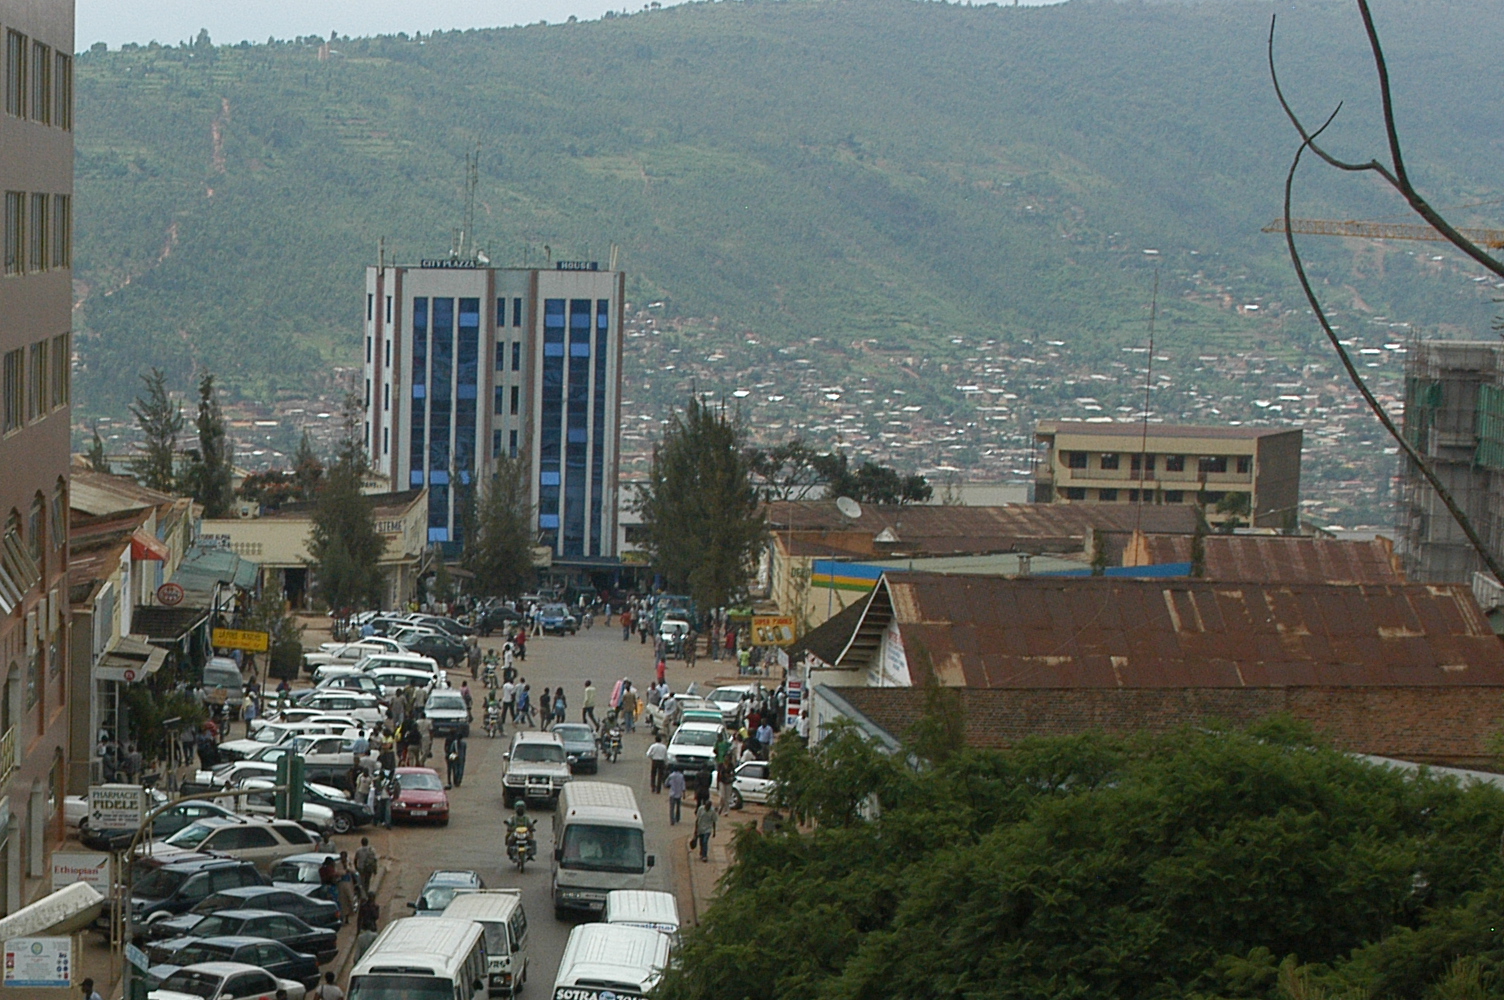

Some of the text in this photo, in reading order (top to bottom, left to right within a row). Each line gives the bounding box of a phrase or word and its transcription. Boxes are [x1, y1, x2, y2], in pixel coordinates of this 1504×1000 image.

[561, 261, 592, 270] HOUSE
[92, 791, 139, 799] PHARMACIE
[93, 800, 139, 810] FIDELE
[54, 865, 99, 877] Ethiopian
